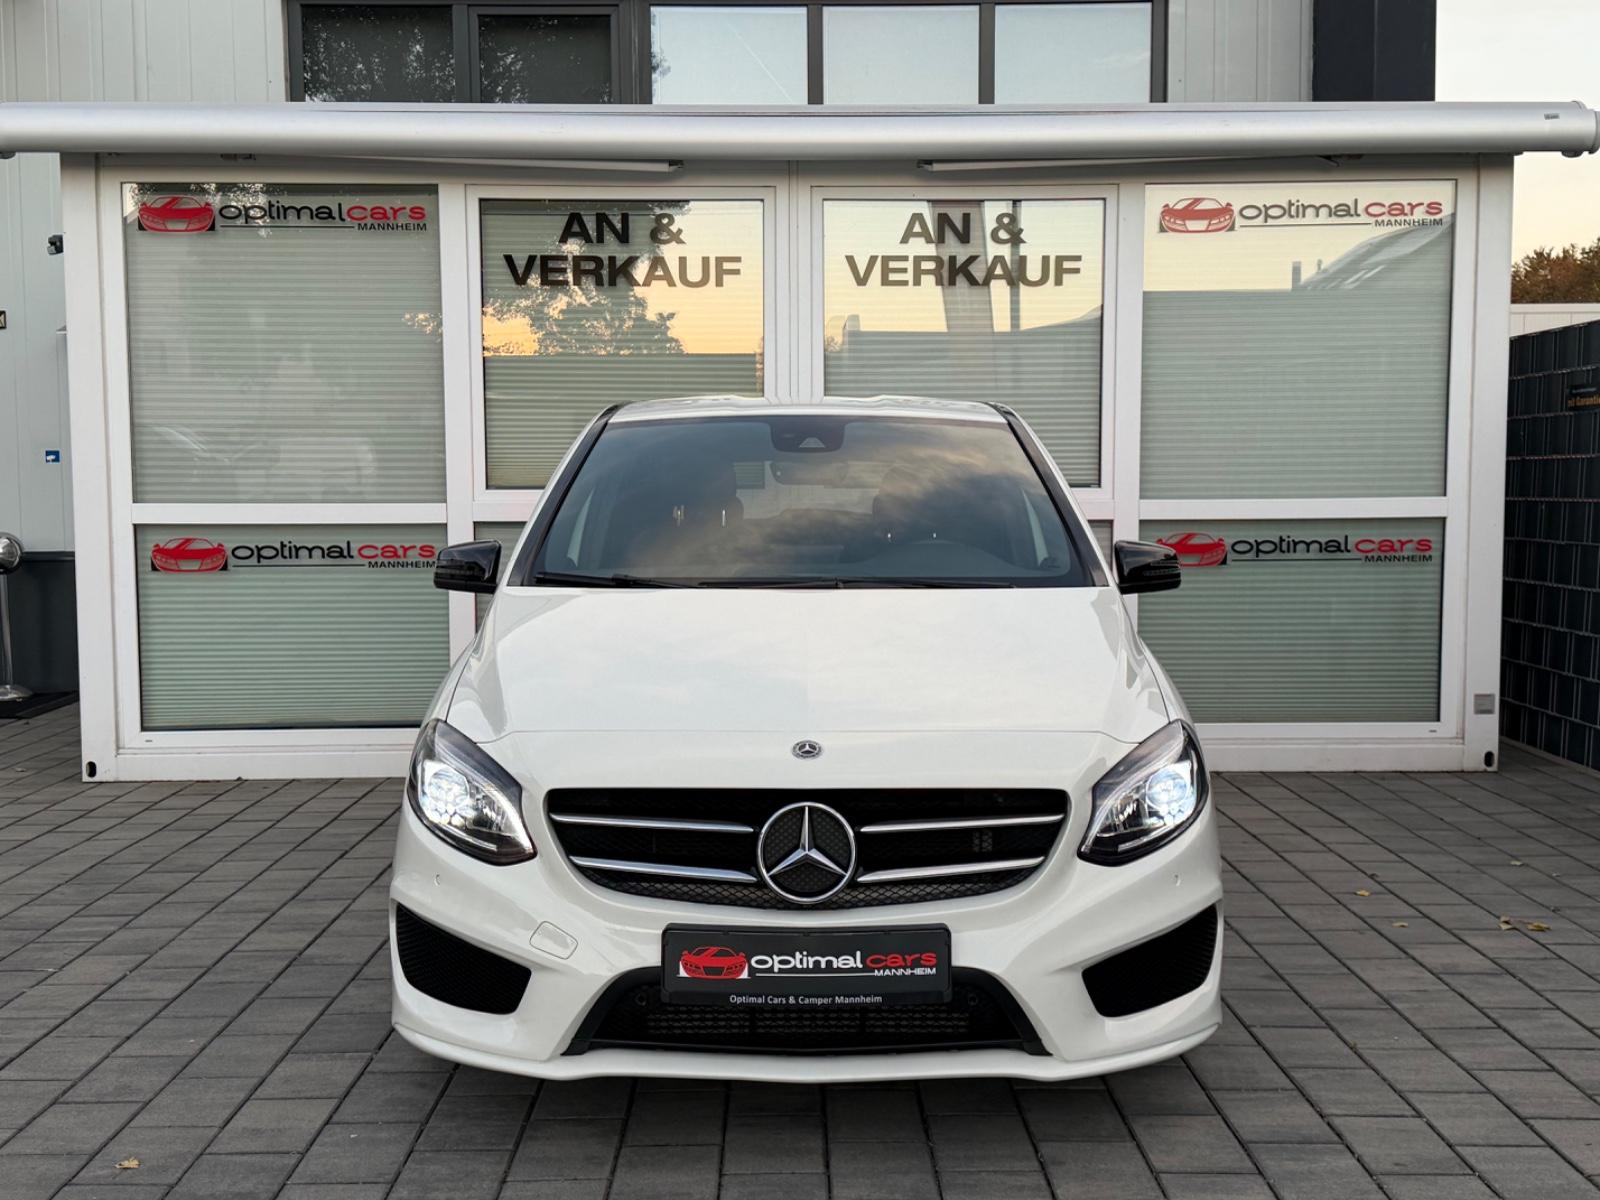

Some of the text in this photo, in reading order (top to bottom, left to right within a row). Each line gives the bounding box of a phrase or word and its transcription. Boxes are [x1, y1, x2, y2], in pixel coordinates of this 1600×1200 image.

[357, 223, 427, 232] MANNHEIM
[1374, 217, 1443, 228] MANNHEIM
[558, 212, 687, 245] AN &
[899, 212, 1027, 245] AN &
[503, 254, 742, 288] VERKAUF
[844, 255, 1082, 288] VERKAUF
[1364, 554, 1433, 563] MANNHEIM
[367, 560, 436, 569] MANNHEIM
[874, 966, 937, 977] MANNHEIM
[729, 994, 883, 1005] Optimal Cars & Camper Mannheim
